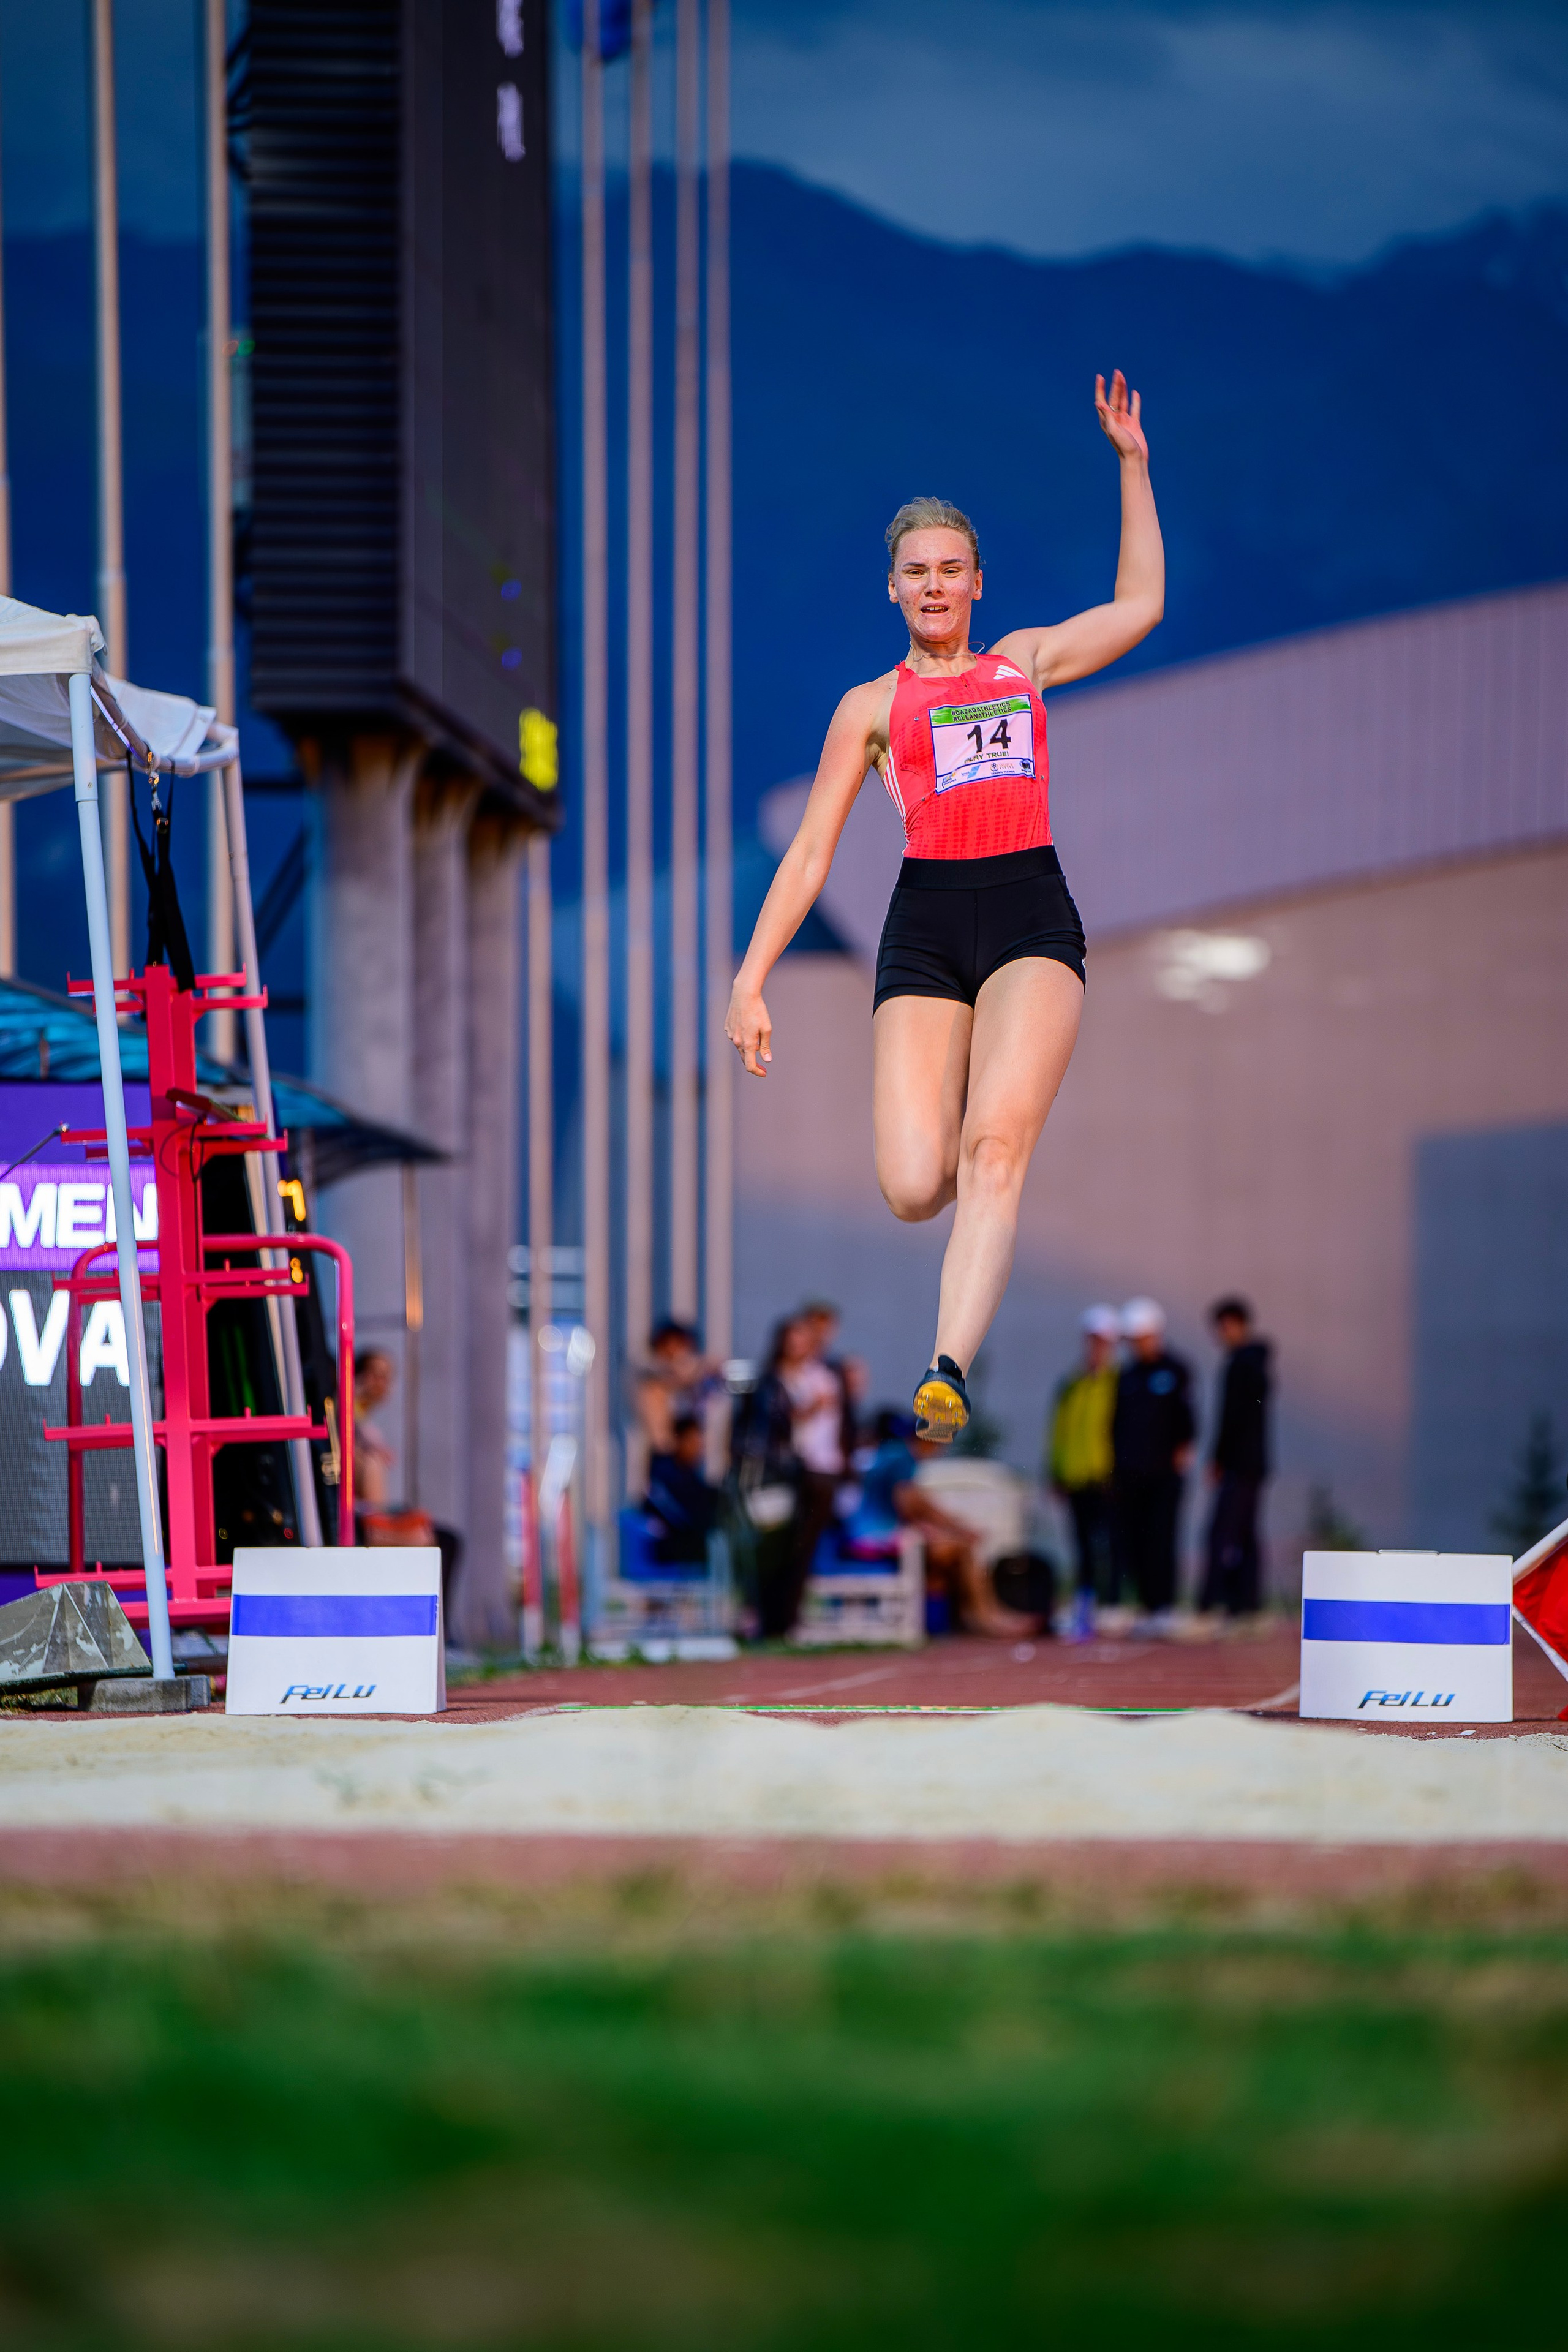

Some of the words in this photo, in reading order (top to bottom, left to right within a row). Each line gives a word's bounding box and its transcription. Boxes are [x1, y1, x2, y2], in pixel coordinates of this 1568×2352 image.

[953, 706, 1012, 722] #CLEANATHLETICS
[967, 718, 1011, 753] 14
[0, 1182, 159, 1248] MEN
[0, 1289, 130, 1387] VA
